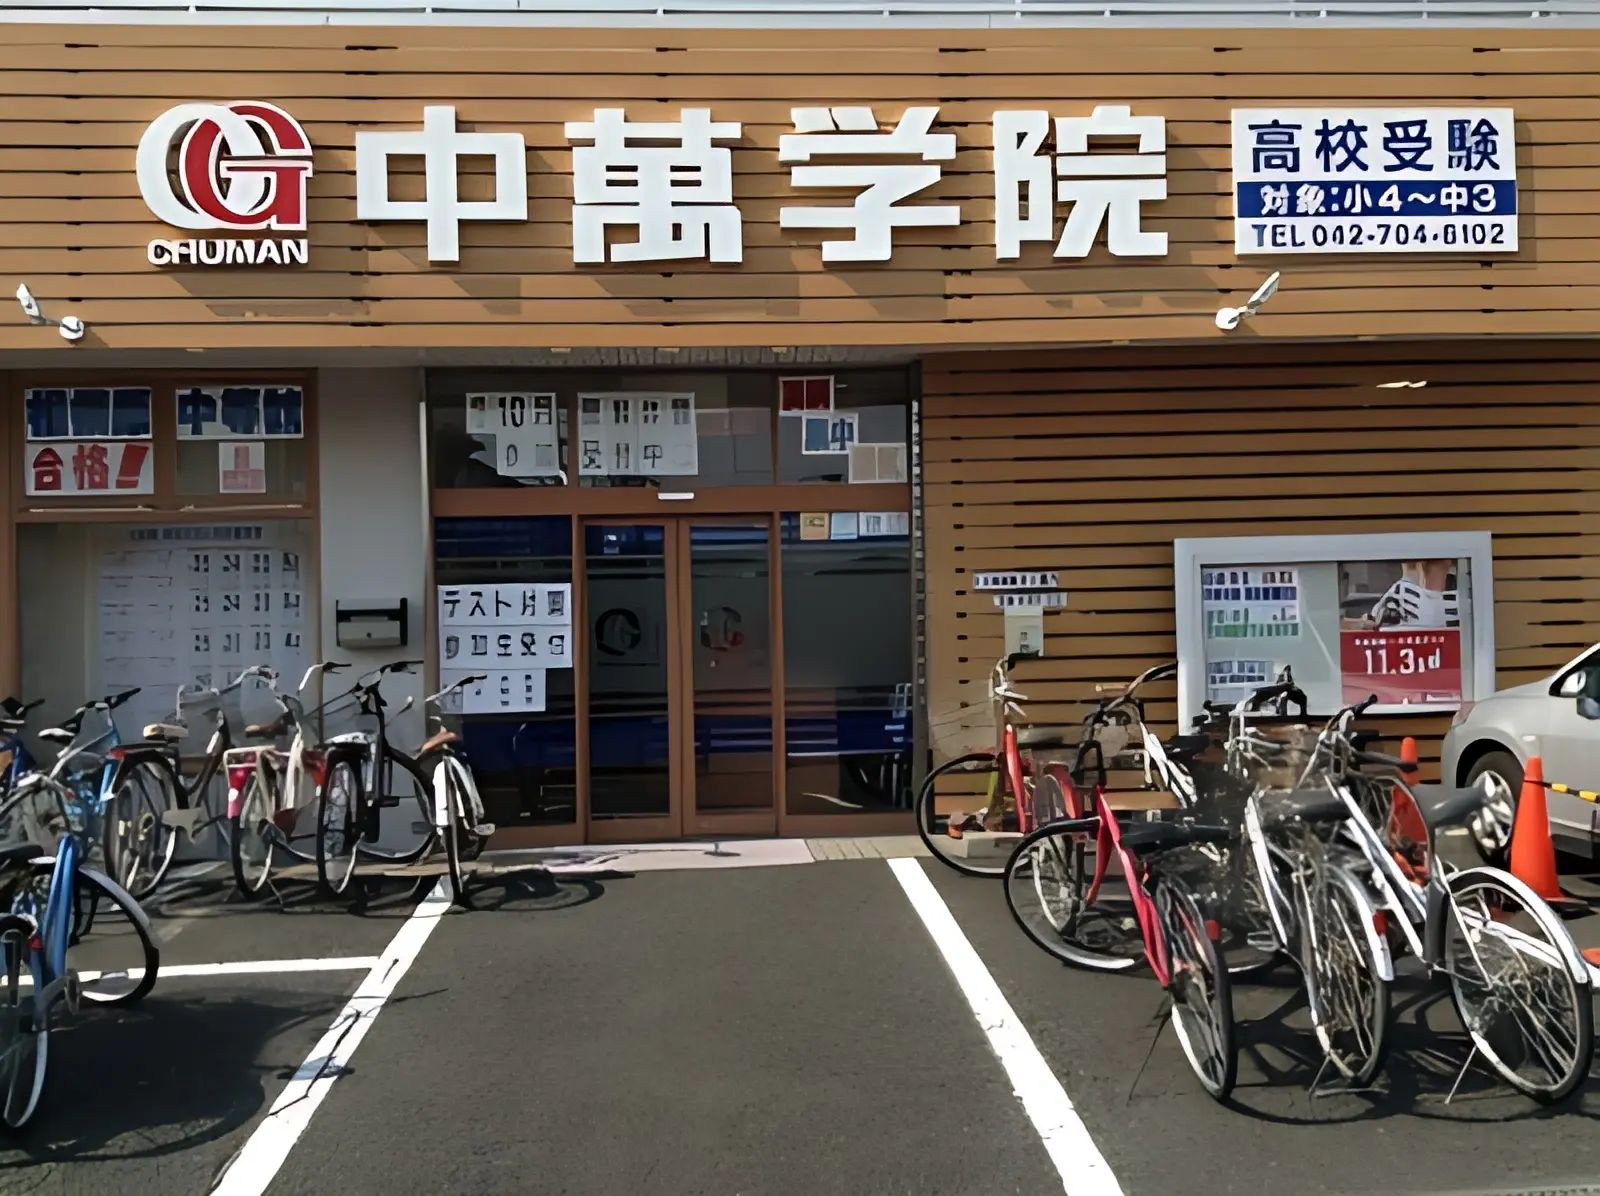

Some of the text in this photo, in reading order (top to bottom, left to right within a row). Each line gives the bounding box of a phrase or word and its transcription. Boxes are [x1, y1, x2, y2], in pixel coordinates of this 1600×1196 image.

[1248, 118, 1501, 173] 高校受験
[354, 104, 1168, 264] 中萬学院
[147, 238, 309, 265] CHUMAN
[1252, 223, 1305, 248] TEL
